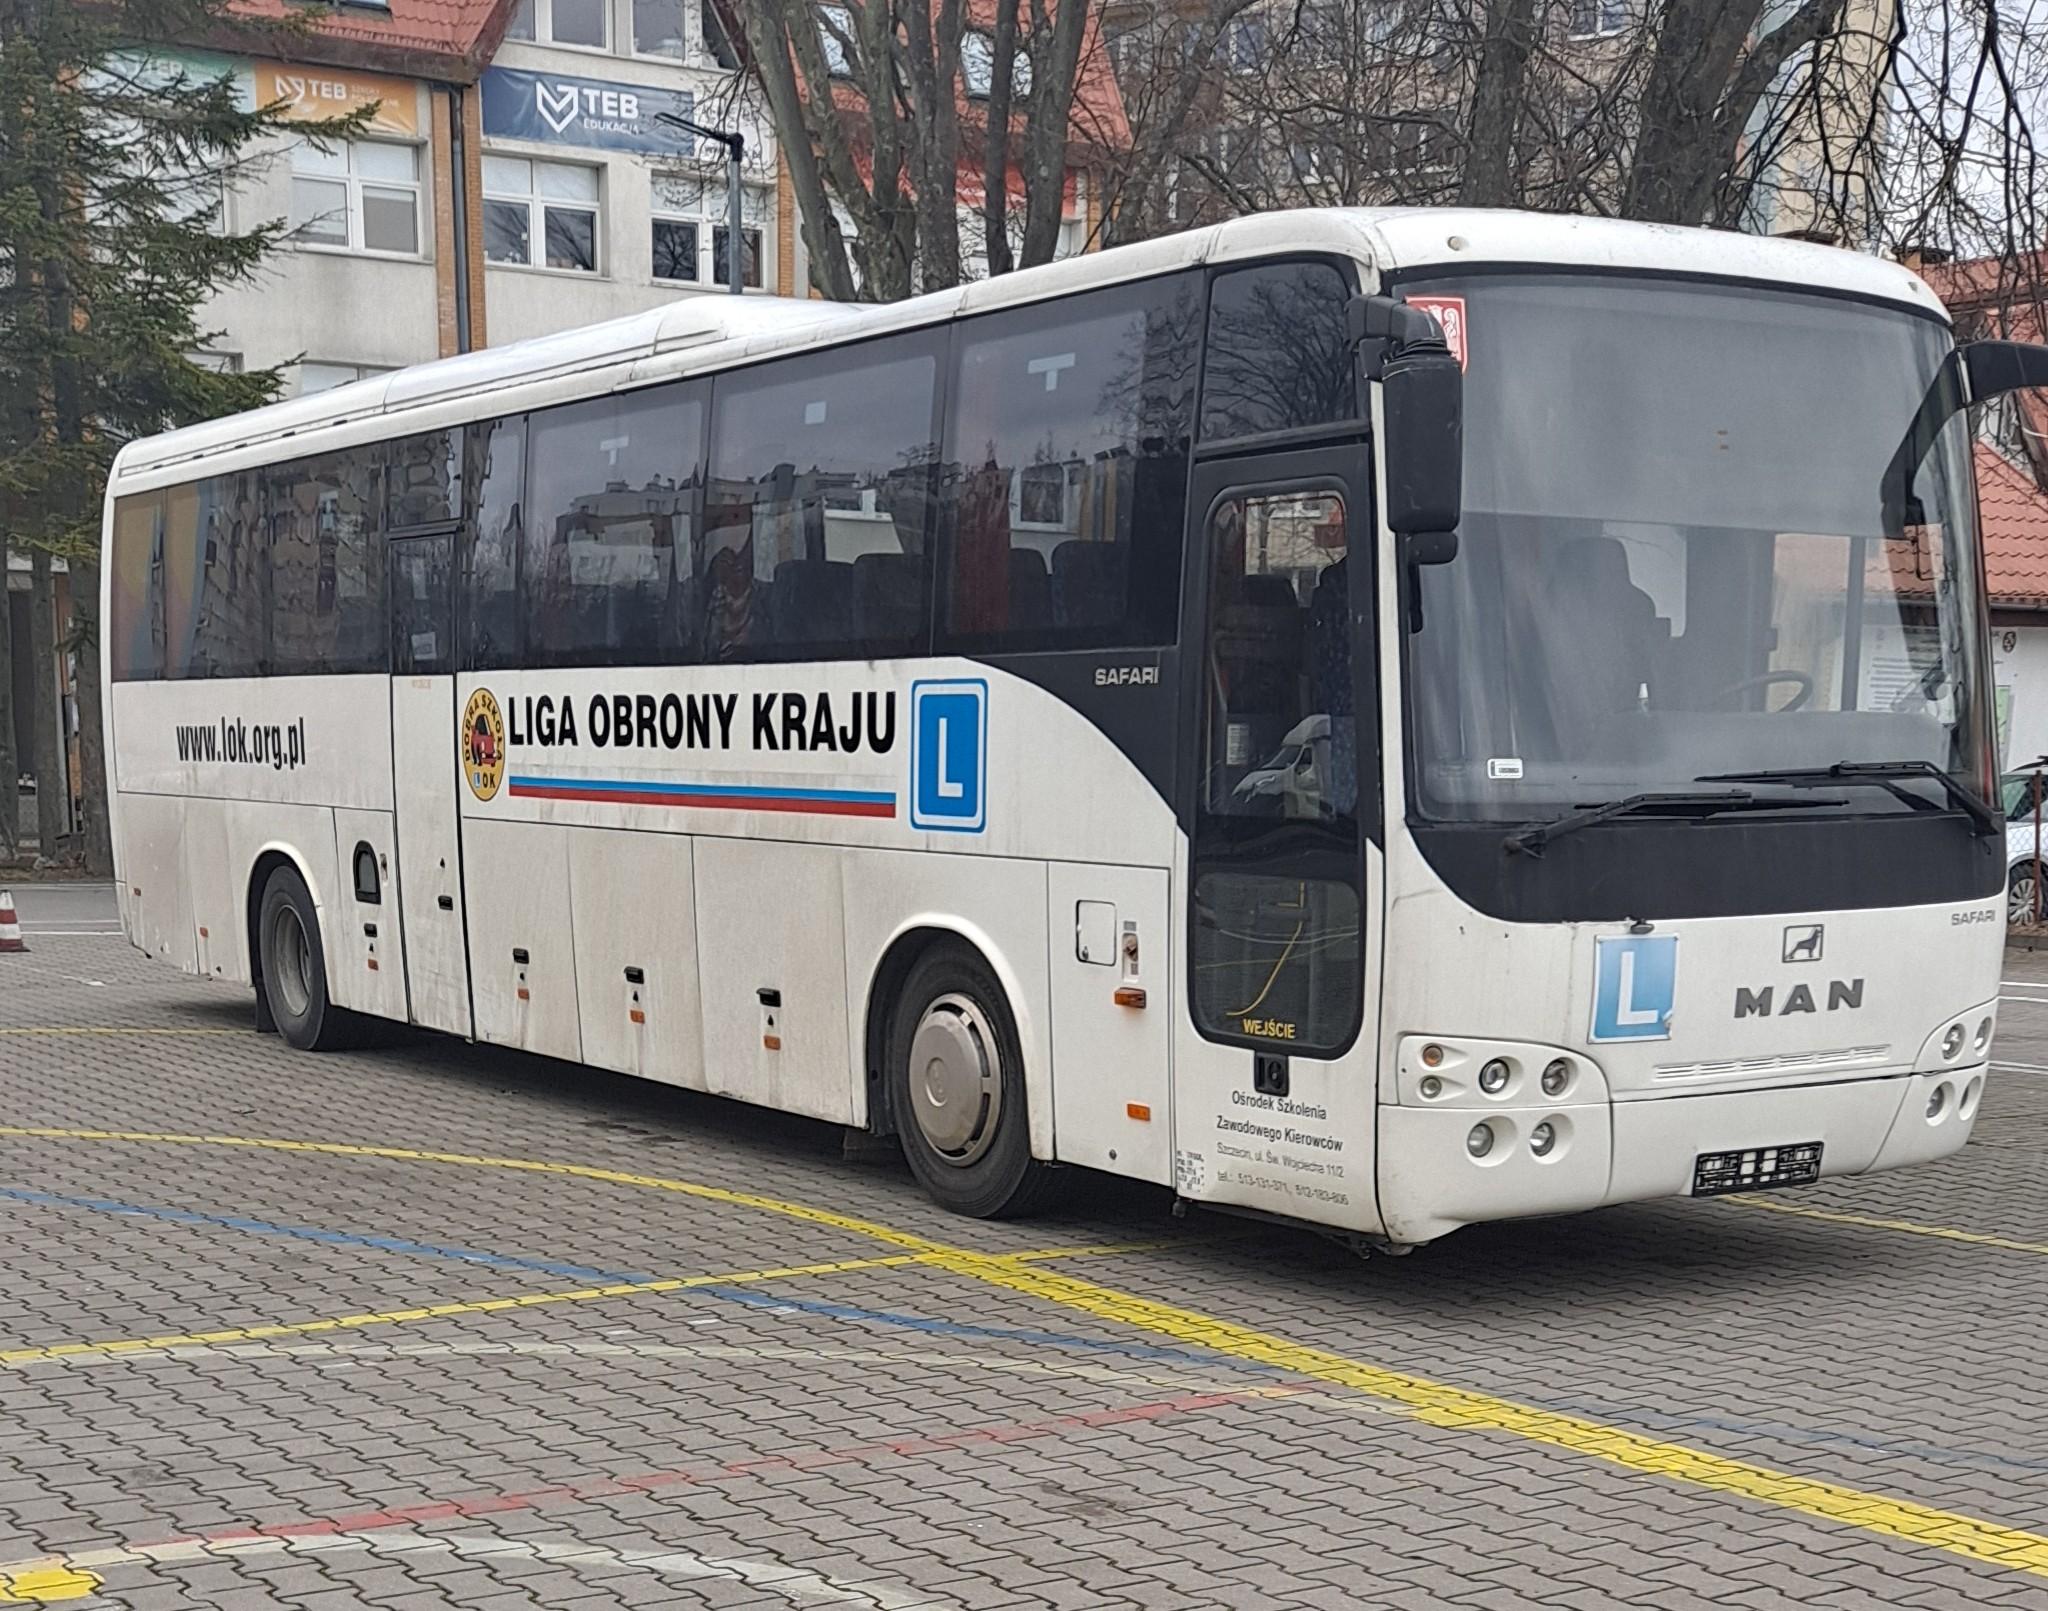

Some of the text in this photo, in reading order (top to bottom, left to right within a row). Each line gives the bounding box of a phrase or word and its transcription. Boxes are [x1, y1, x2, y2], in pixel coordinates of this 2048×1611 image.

[311, 78, 347, 100] TEB
[583, 88, 639, 120] TEB
[584, 118, 639, 136] EDUKACJA
[1095, 666, 1159, 685] SAFARI
[508, 691, 897, 754] LIGA OBRONY KRAJU
[176, 716, 306, 770] www.lok.org.pl
[938, 717, 964, 798] L
[1951, 909, 1996, 926] SAFARI
[1616, 951, 1659, 1026] L
[1733, 978, 1864, 1019] MAN
[1243, 1018, 1296, 1039] WEJŚCIE
[1232, 1090, 1327, 1120] Ośrodek Szkolenia
[1216, 1115, 1344, 1152] Zawodowego Kierowców
